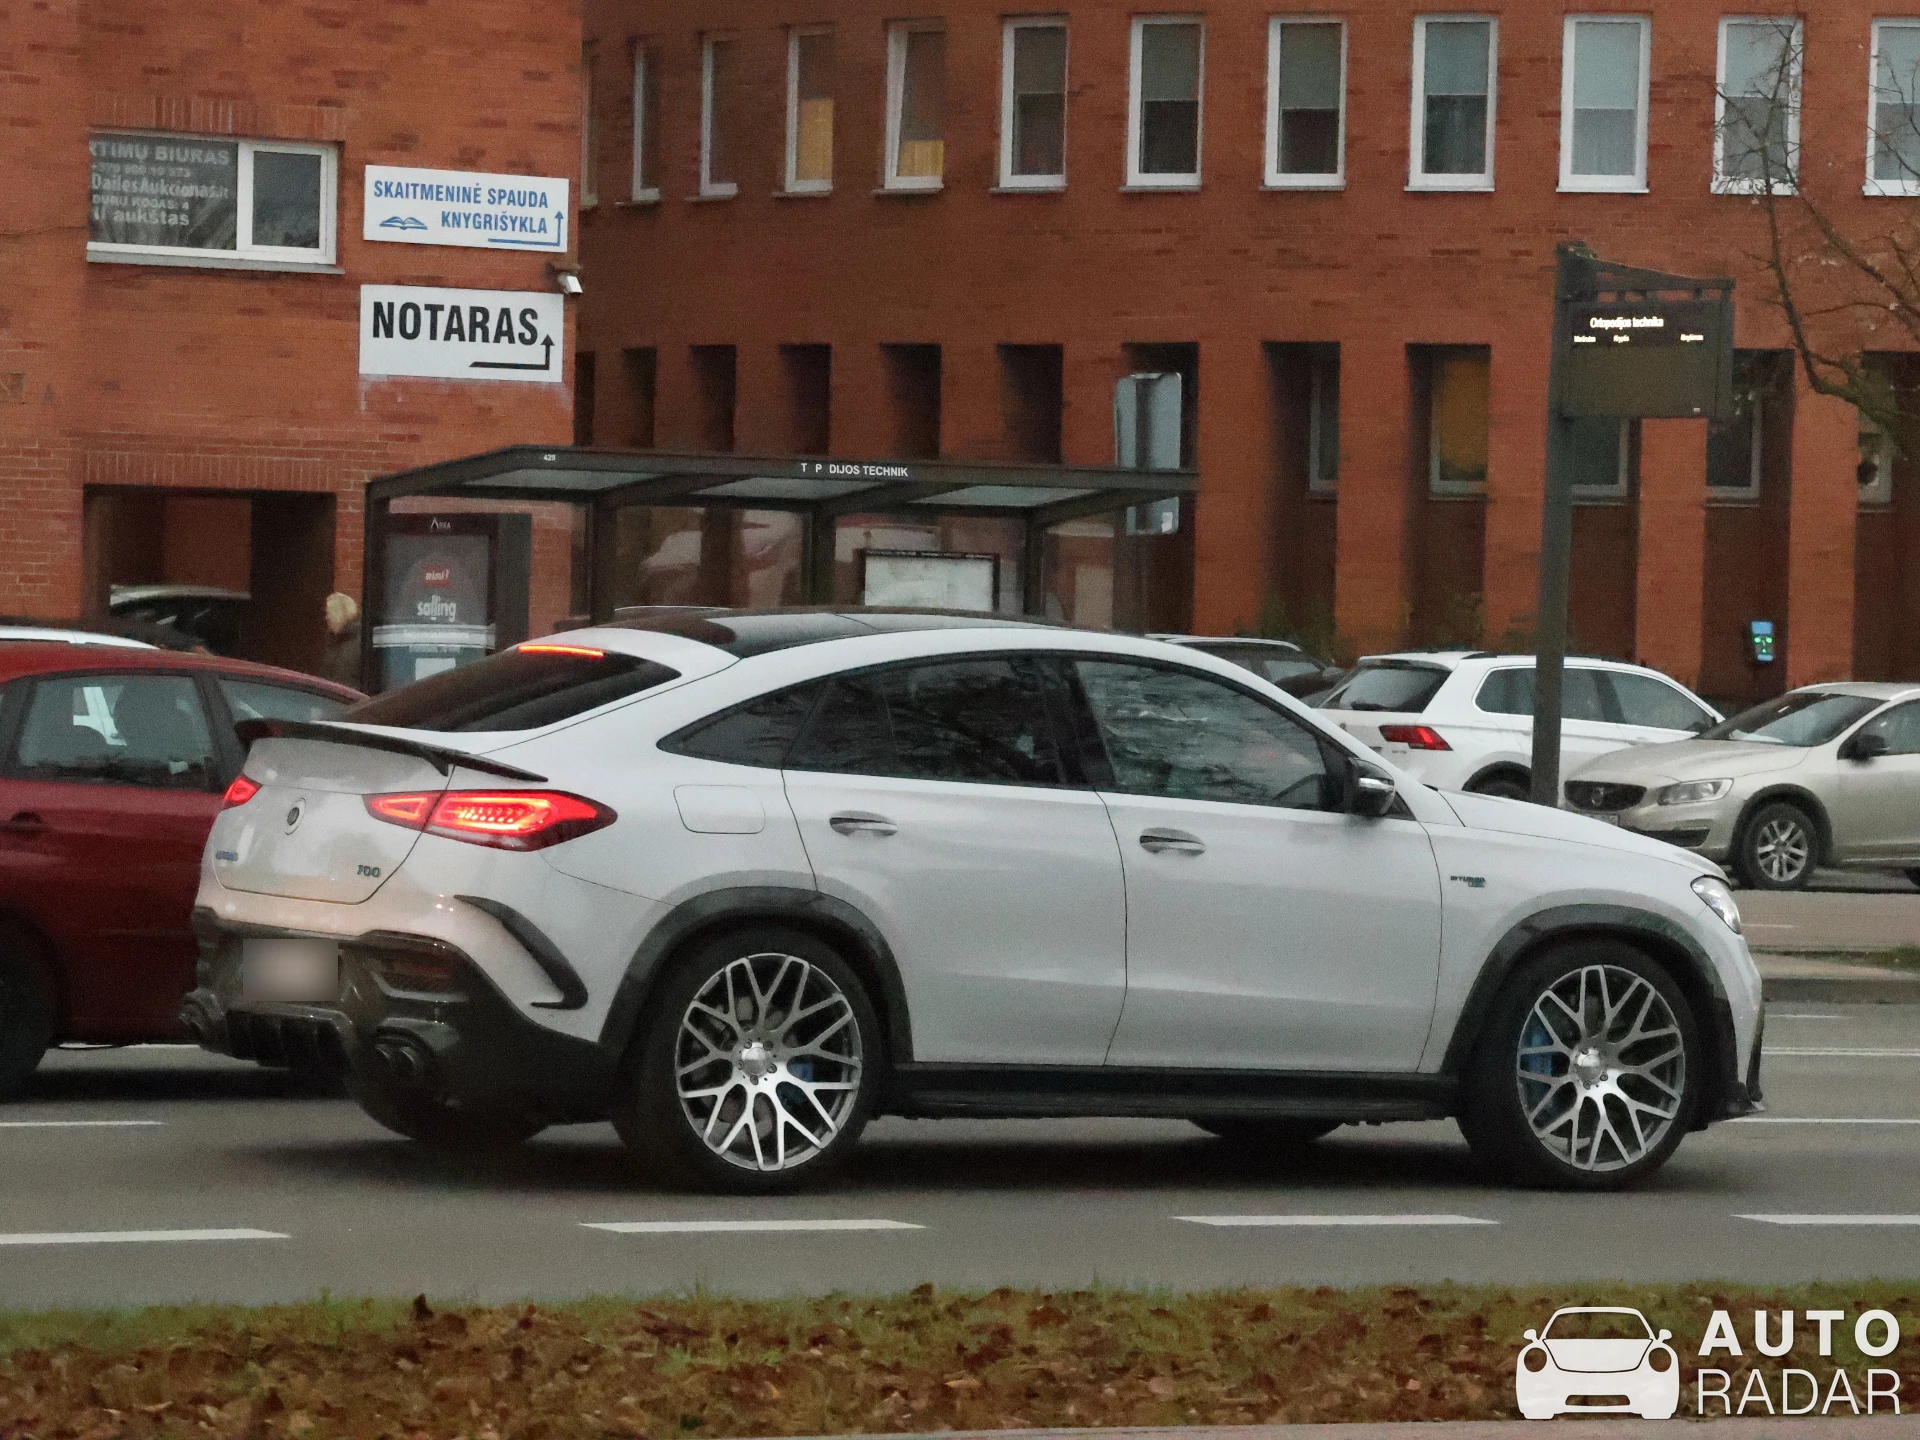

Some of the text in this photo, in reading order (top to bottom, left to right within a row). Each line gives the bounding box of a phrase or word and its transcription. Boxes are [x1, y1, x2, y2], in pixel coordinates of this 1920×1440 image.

[88, 141, 231, 165] TIMŲ BIURAS
[374, 180, 549, 209] SKAITMENINĖ SPAUDA
[441, 210, 548, 234] KNYGRIŠYKLA
[372, 301, 539, 346] NOTARAS
[829, 464, 861, 475] DIJOS
[863, 465, 909, 477] TECHNIK
[357, 864, 380, 878] 700
